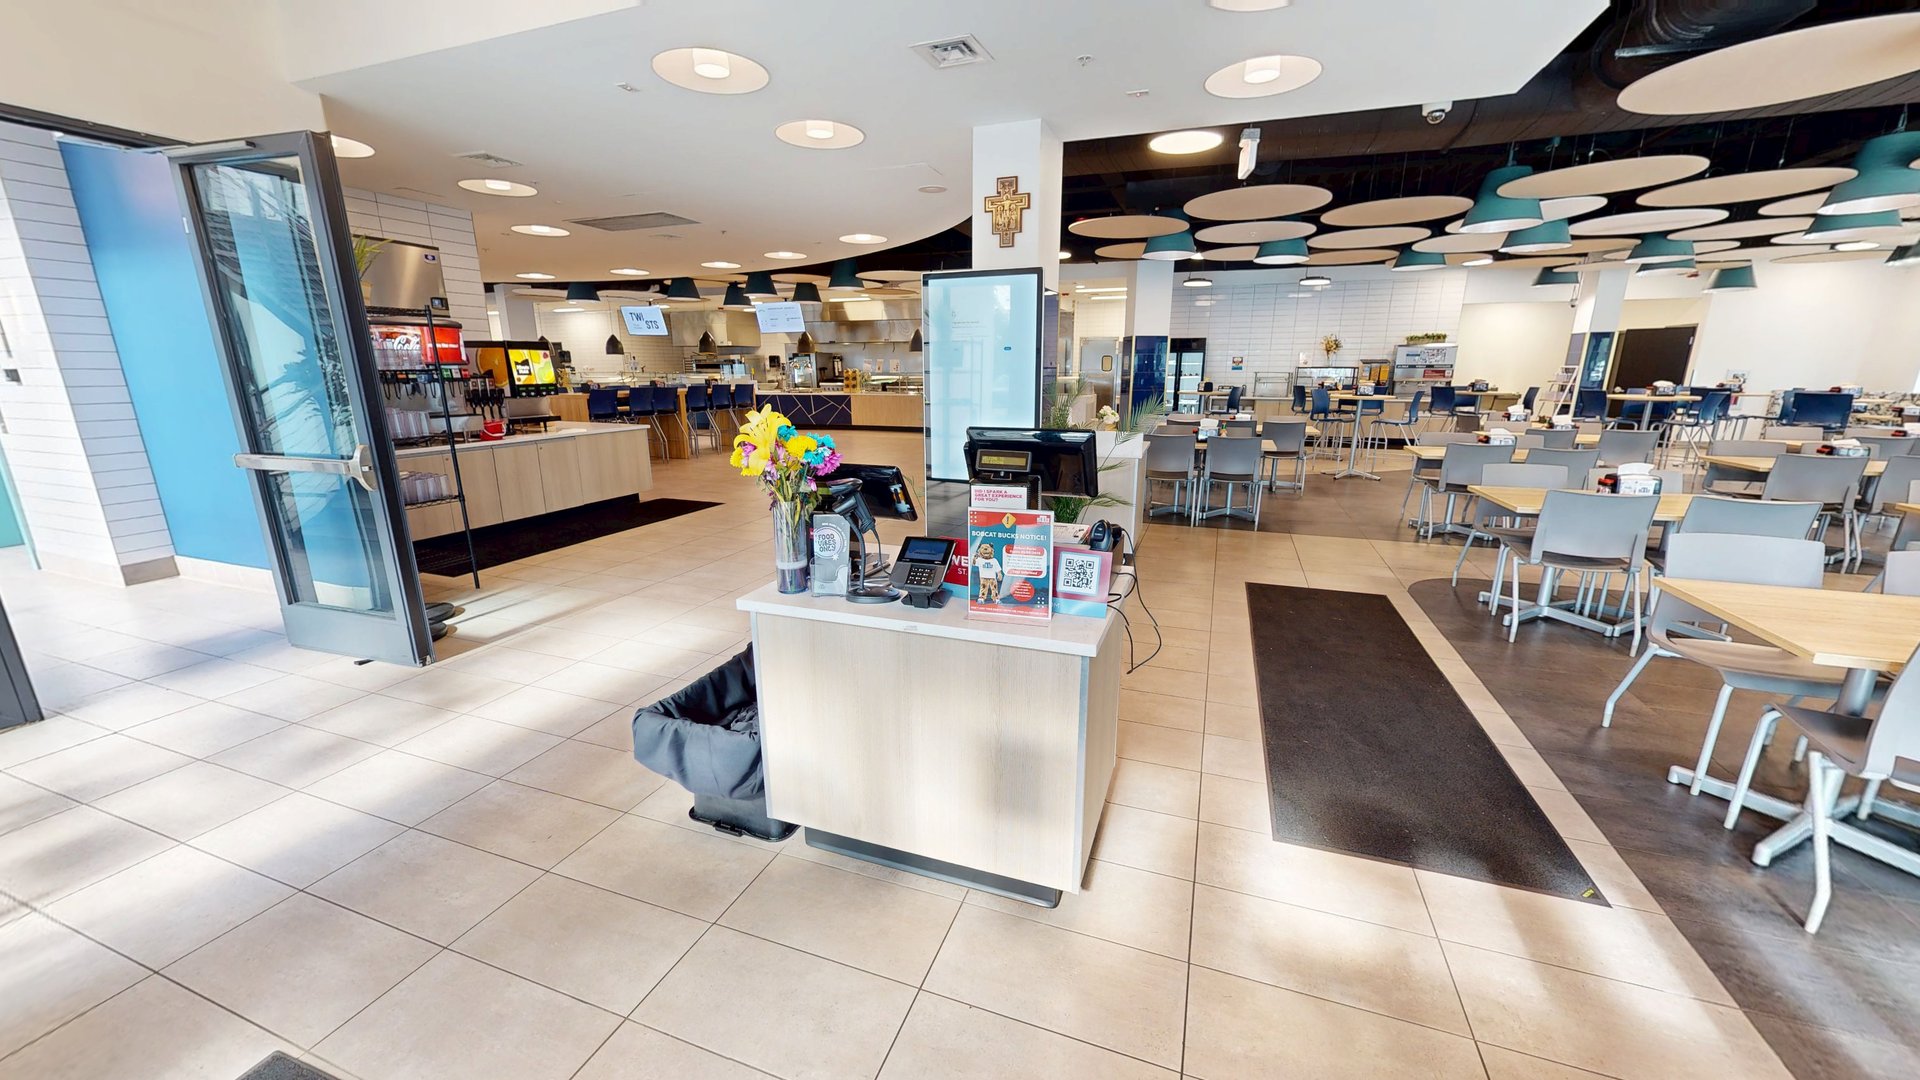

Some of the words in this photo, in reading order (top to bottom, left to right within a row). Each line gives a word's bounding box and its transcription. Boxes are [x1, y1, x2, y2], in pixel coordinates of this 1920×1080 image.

[629, 312, 645, 321] TWI
[645, 320, 659, 329] STS
[971, 530, 997, 538] BOBCAT
[1020, 533, 1047, 541] NOTICE!
